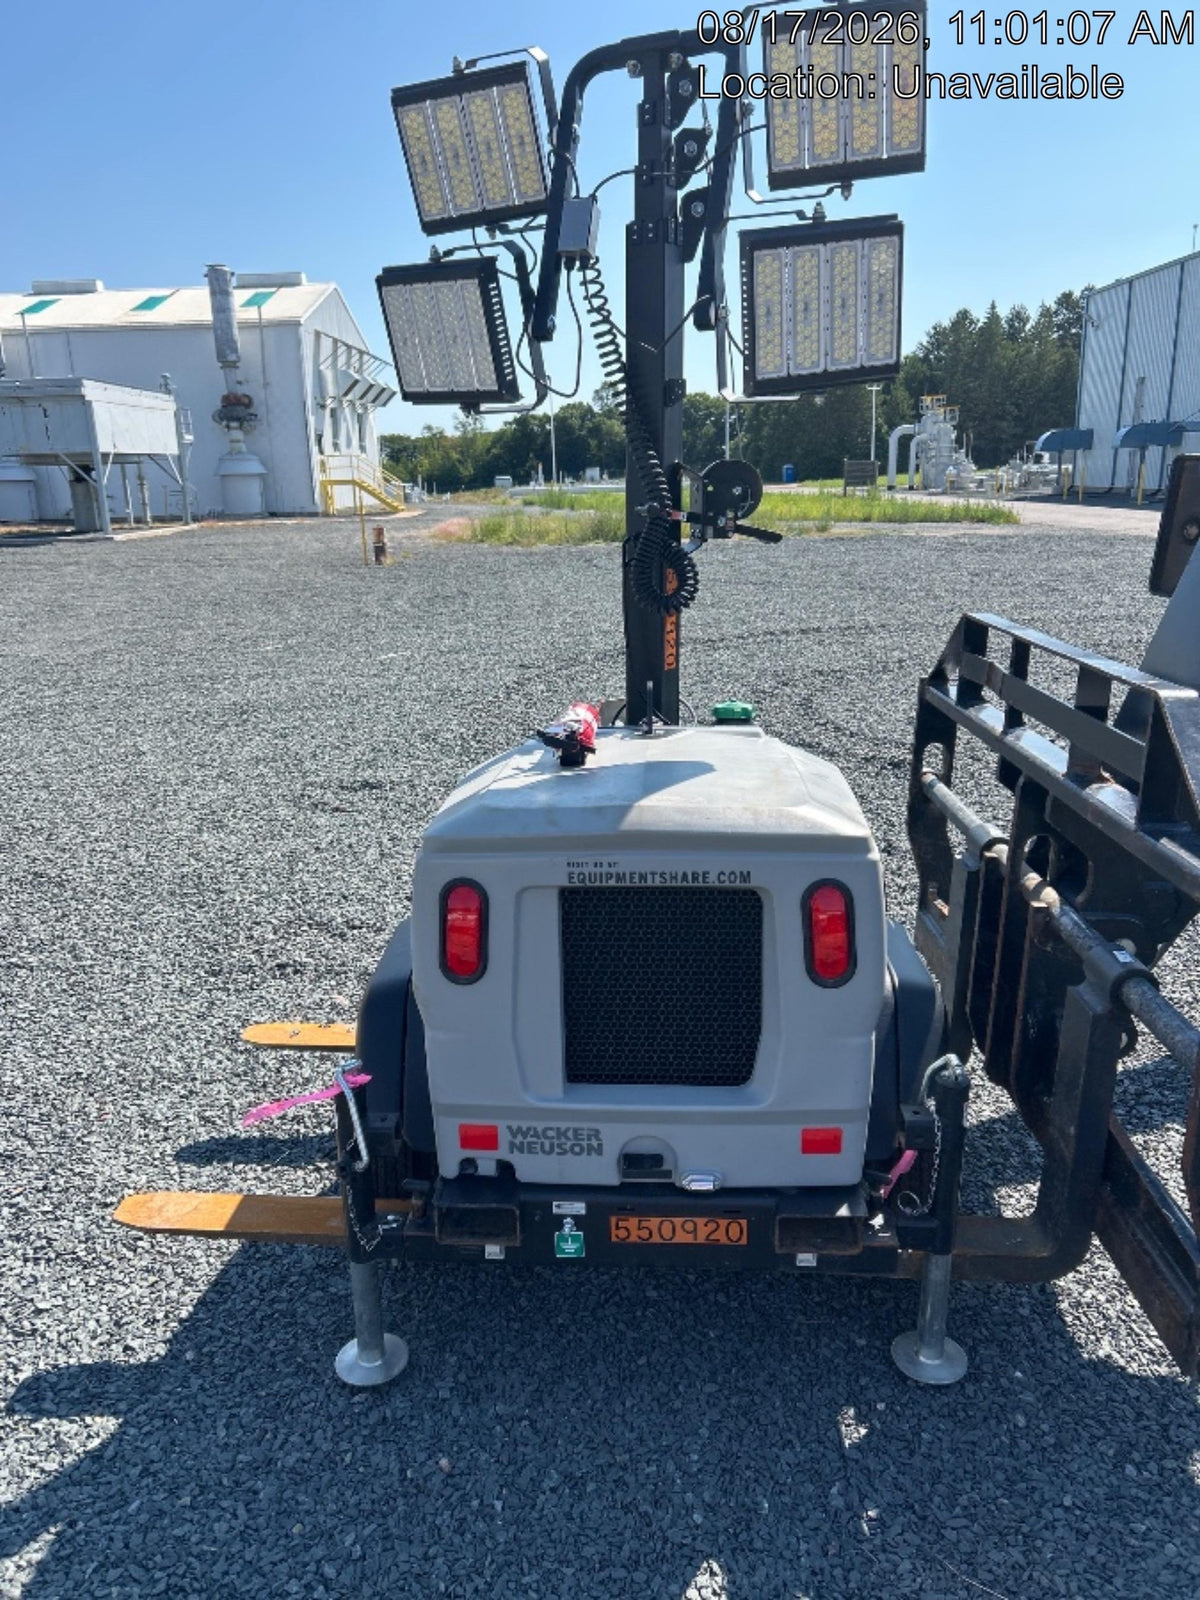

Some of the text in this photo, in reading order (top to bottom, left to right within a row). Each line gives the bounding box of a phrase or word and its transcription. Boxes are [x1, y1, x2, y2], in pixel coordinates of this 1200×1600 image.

[567, 871, 752, 886] EQUIPMENTSHARE.COM
[506, 1125, 602, 1141] WACKER
[508, 1141, 604, 1156] NEUSON
[614, 1218, 744, 1244] 550920
